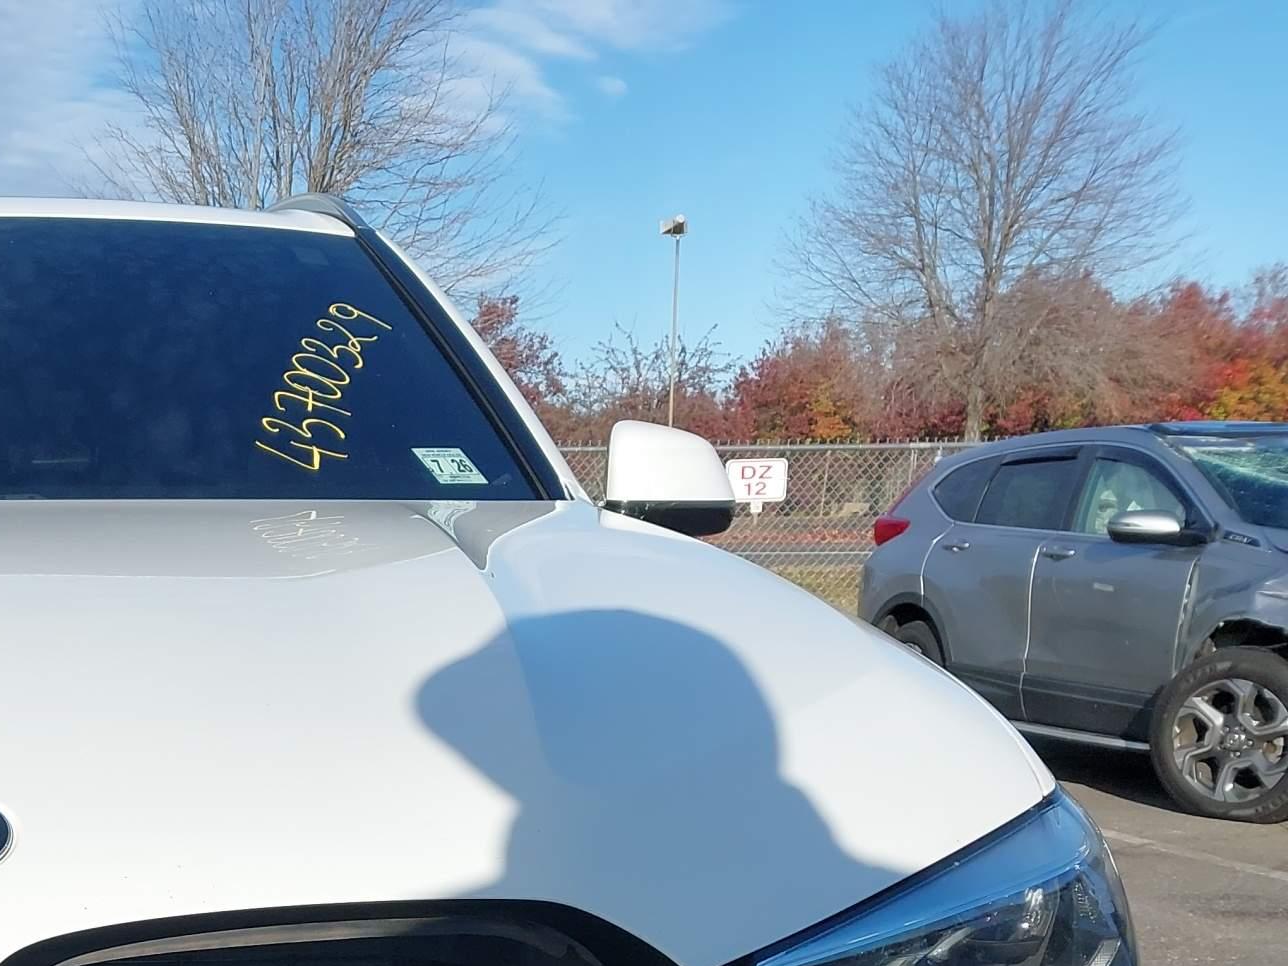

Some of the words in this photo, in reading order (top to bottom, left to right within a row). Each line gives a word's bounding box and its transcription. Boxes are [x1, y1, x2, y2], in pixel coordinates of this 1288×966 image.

[254, 301, 394, 472] 43700329
[451, 459, 473, 473] 26
[740, 465, 773, 480] DZ
[743, 481, 767, 496] 12
